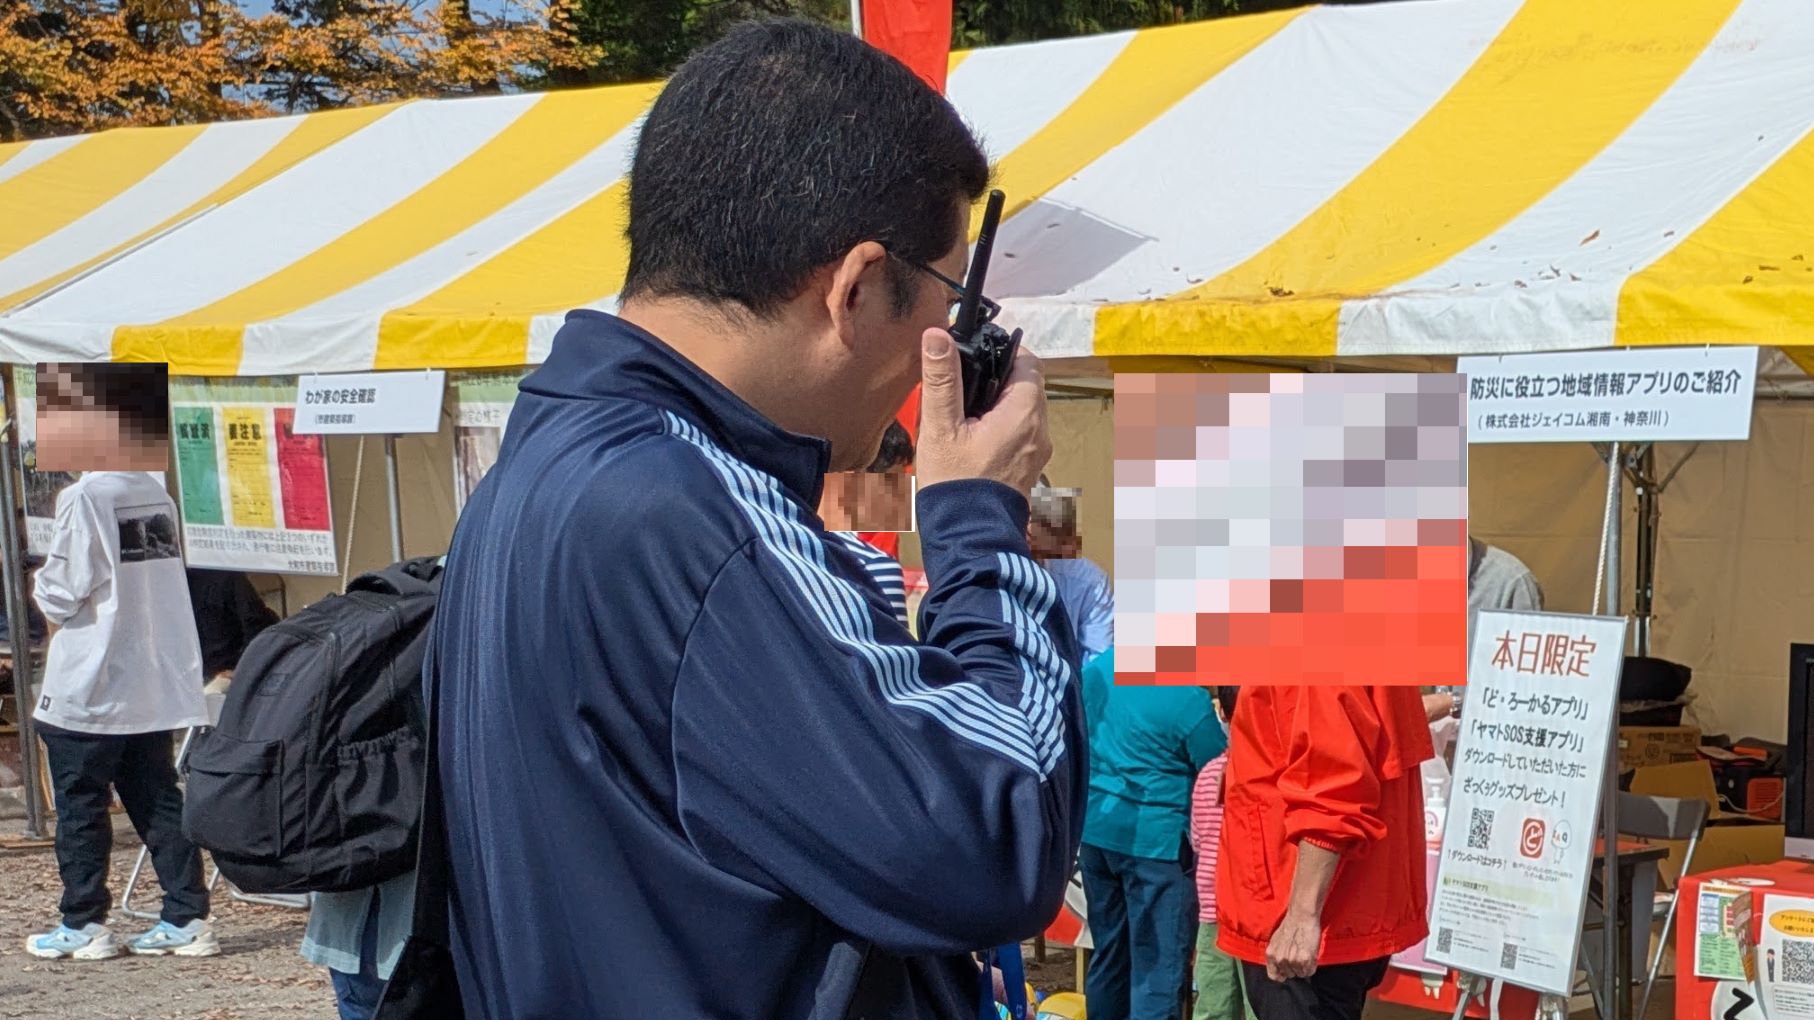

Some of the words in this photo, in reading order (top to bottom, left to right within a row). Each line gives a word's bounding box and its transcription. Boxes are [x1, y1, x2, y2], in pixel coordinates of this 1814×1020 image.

[305, 388, 376, 405] わが家の安全確認
[1470, 369, 1742, 400] 防災に役立つ地域情報アプリのご紹介
[229, 424, 262, 440] 要注意
[1491, 630, 1597, 677] 本日限定
[1482, 687, 1588, 720] 「ど・ろーかるアプリ」
[1471, 719, 1584, 753] 「ヤマトSOS支援アプリ」
[1465, 748, 1587, 778] ダウンロードしていただいた方に
